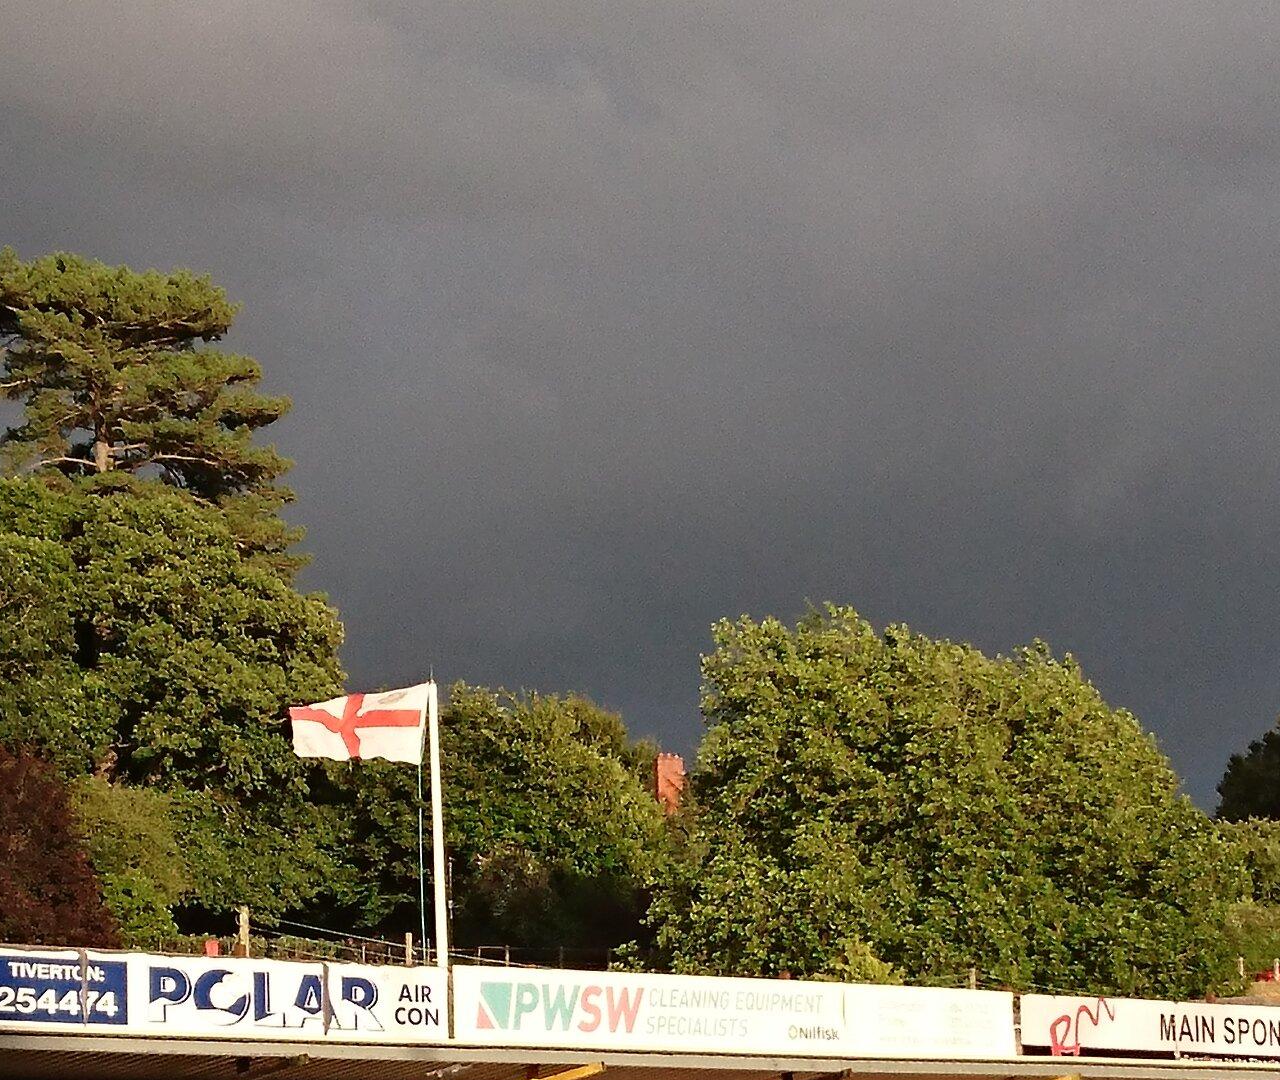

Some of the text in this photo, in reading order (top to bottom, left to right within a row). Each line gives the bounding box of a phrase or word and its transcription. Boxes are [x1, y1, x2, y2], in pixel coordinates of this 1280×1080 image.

[148, 966, 385, 1031] POLAR
[399, 984, 432, 1003] AIR
[649, 988, 824, 1014] CLEANING EQUIPMENT
[395, 1006, 439, 1026] CON
[512, 983, 644, 1033] PWSW
[645, 1016, 749, 1038] SPECIALISTS
[799, 1026, 841, 1041] Nilfisk
[1160, 1013, 1216, 1043] MAIN
